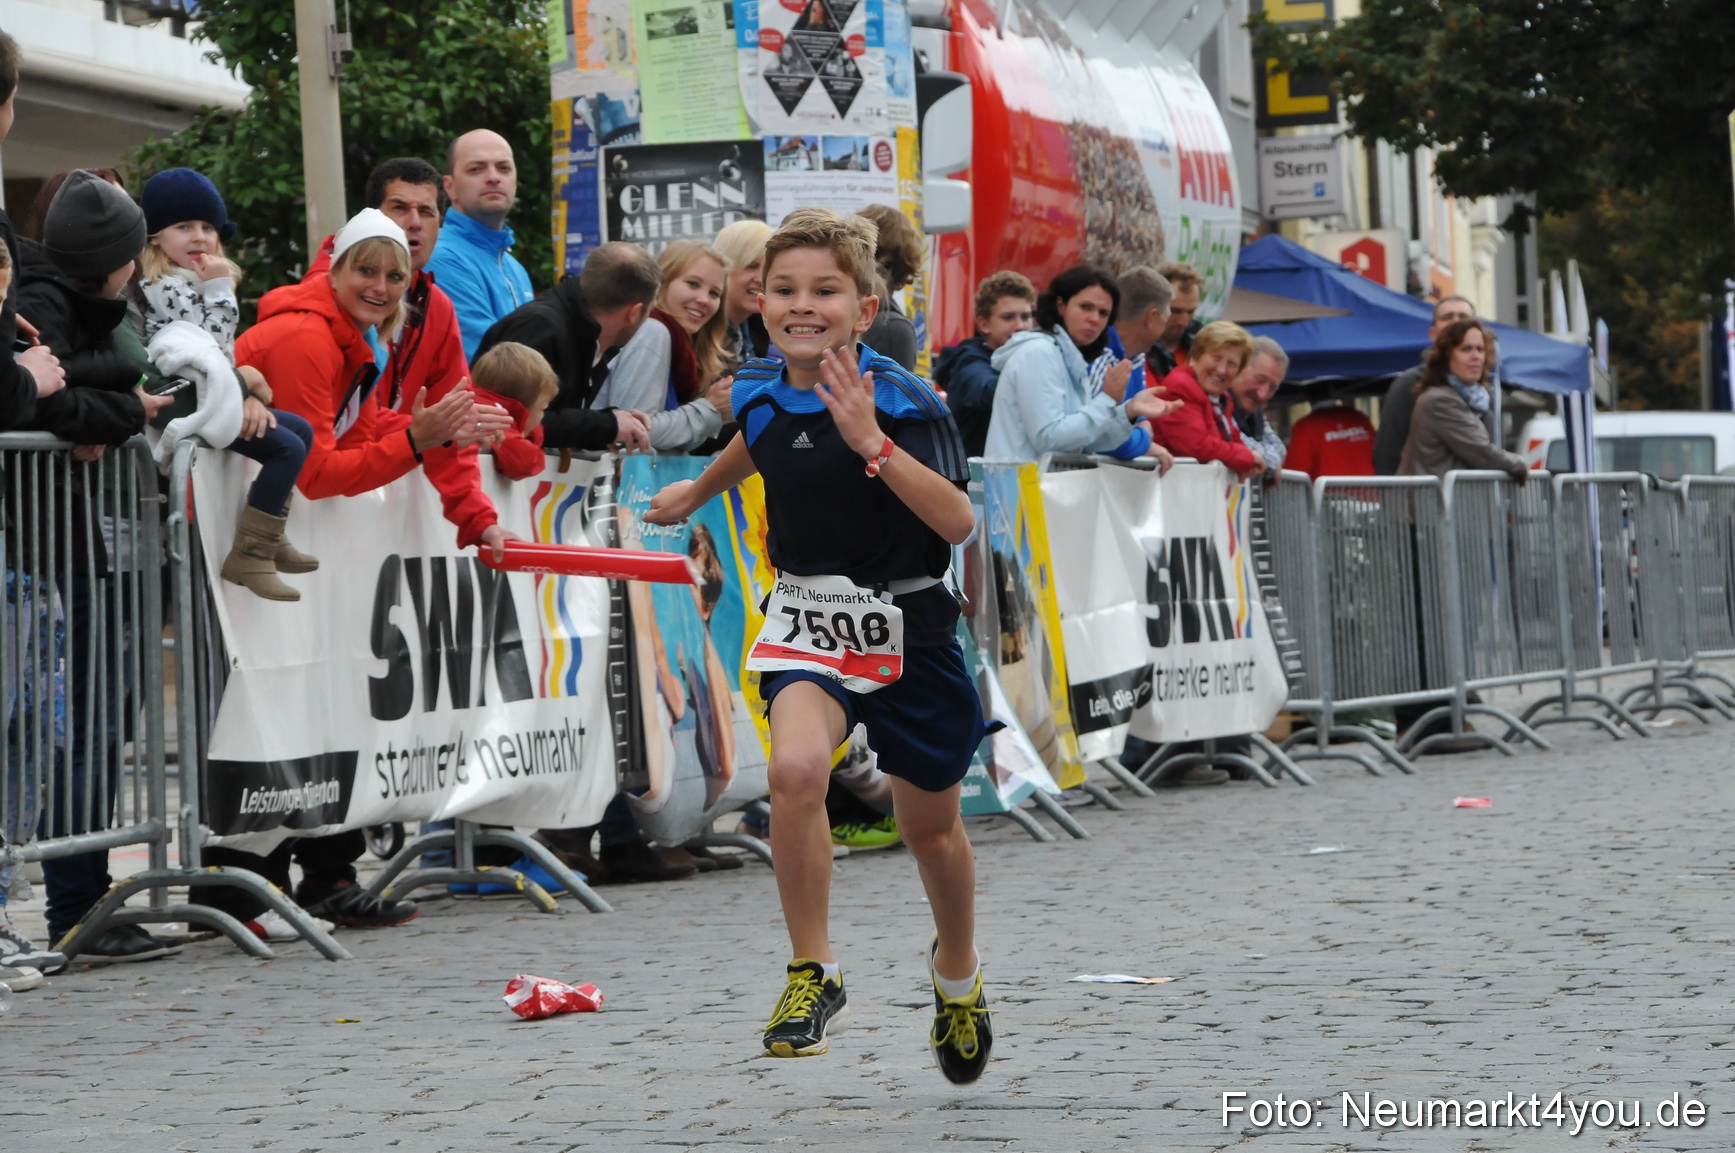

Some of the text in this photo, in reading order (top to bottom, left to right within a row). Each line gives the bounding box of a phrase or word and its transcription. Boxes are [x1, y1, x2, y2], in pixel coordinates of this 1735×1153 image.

[1274, 161, 1328, 178] Stern
[620, 181, 746, 214] GLENN
[808, 589, 872, 604] Neumarkt
[781, 606, 890, 652] 7598
[890, 645, 897, 653] K
[474, 717, 586, 780] neumarkt
